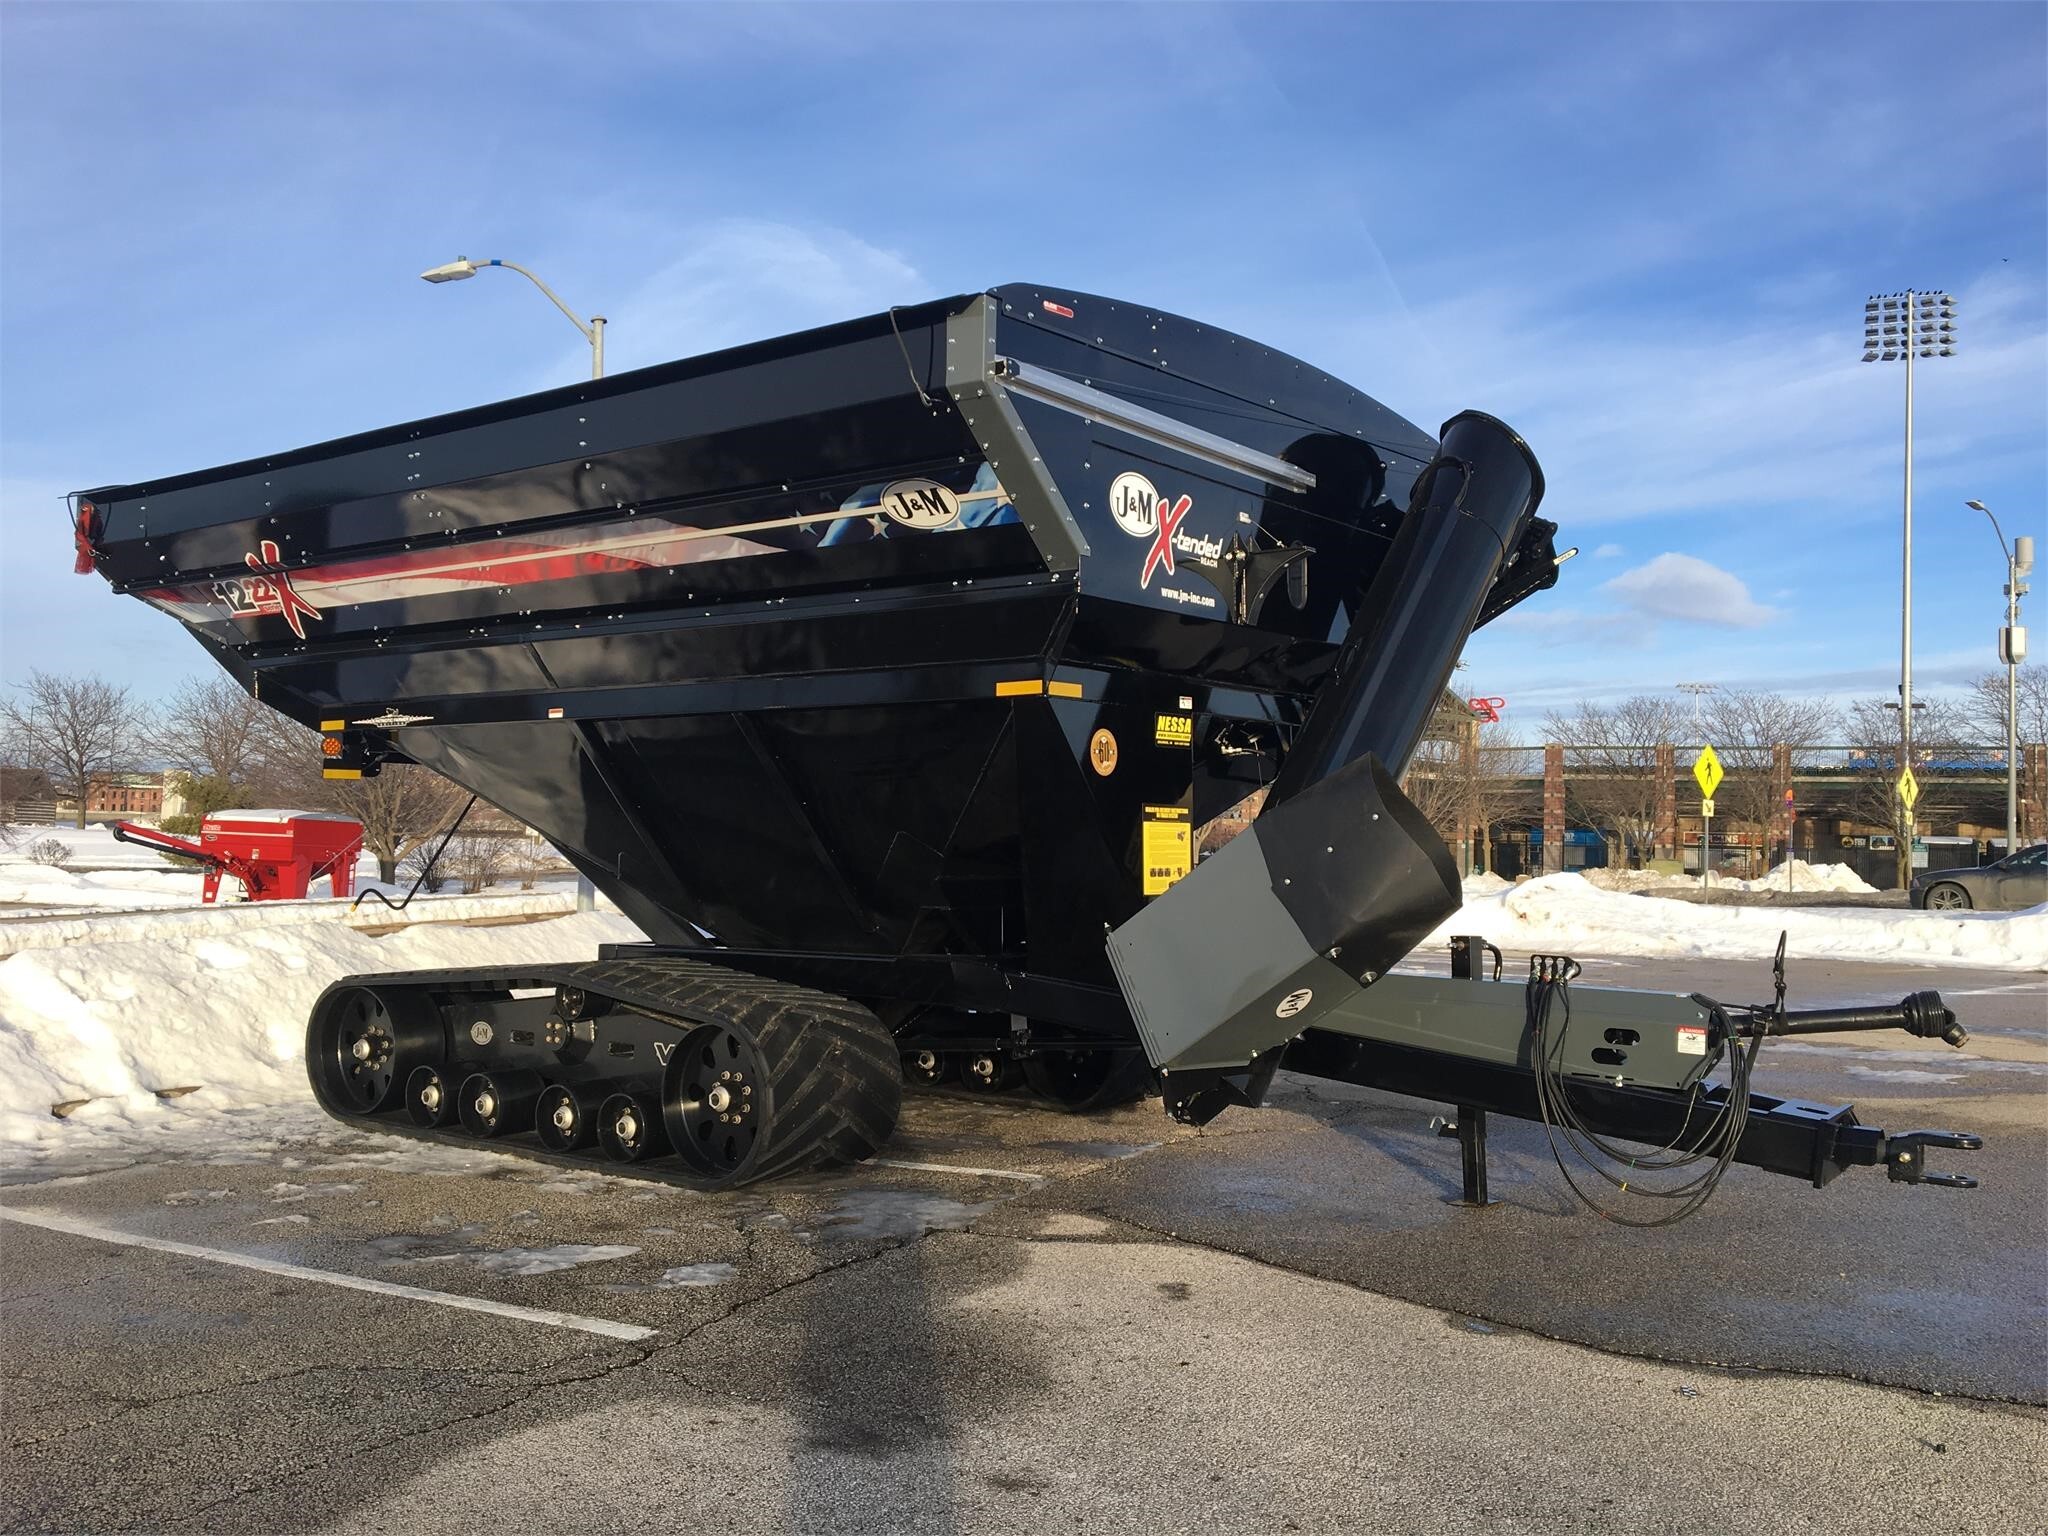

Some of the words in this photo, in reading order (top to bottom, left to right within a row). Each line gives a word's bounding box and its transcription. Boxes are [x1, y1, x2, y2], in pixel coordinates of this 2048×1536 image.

[890, 487, 953, 520] J&M
[1115, 485, 1153, 526] J&M
[1200, 556, 1218, 568] REACH
[1160, 586, 1216, 608] www.jm-inc.com
[1157, 715, 1192, 733] NESSA
[1280, 991, 1310, 1016] J&M
